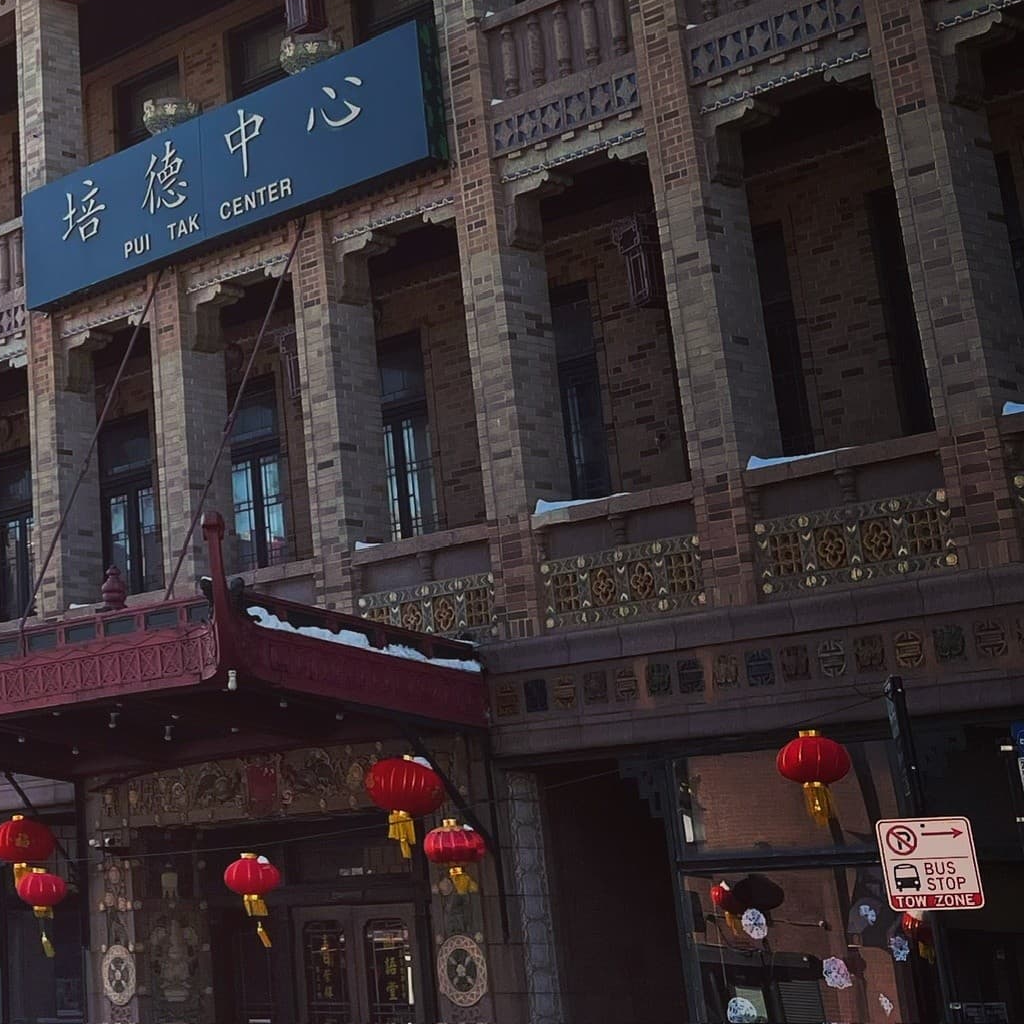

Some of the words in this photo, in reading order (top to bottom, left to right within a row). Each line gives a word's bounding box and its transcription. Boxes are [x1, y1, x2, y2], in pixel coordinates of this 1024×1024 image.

[62, 76, 362, 242] 培德中心
[124, 236, 151, 258] PUI
[167, 213, 200, 241] TAK
[219, 177, 293, 220] CENTER
[923, 861, 956, 875] BUS
[926, 876, 966, 891] STOP
[895, 896, 927, 908] TOW
[935, 894, 975, 907] ZONE
